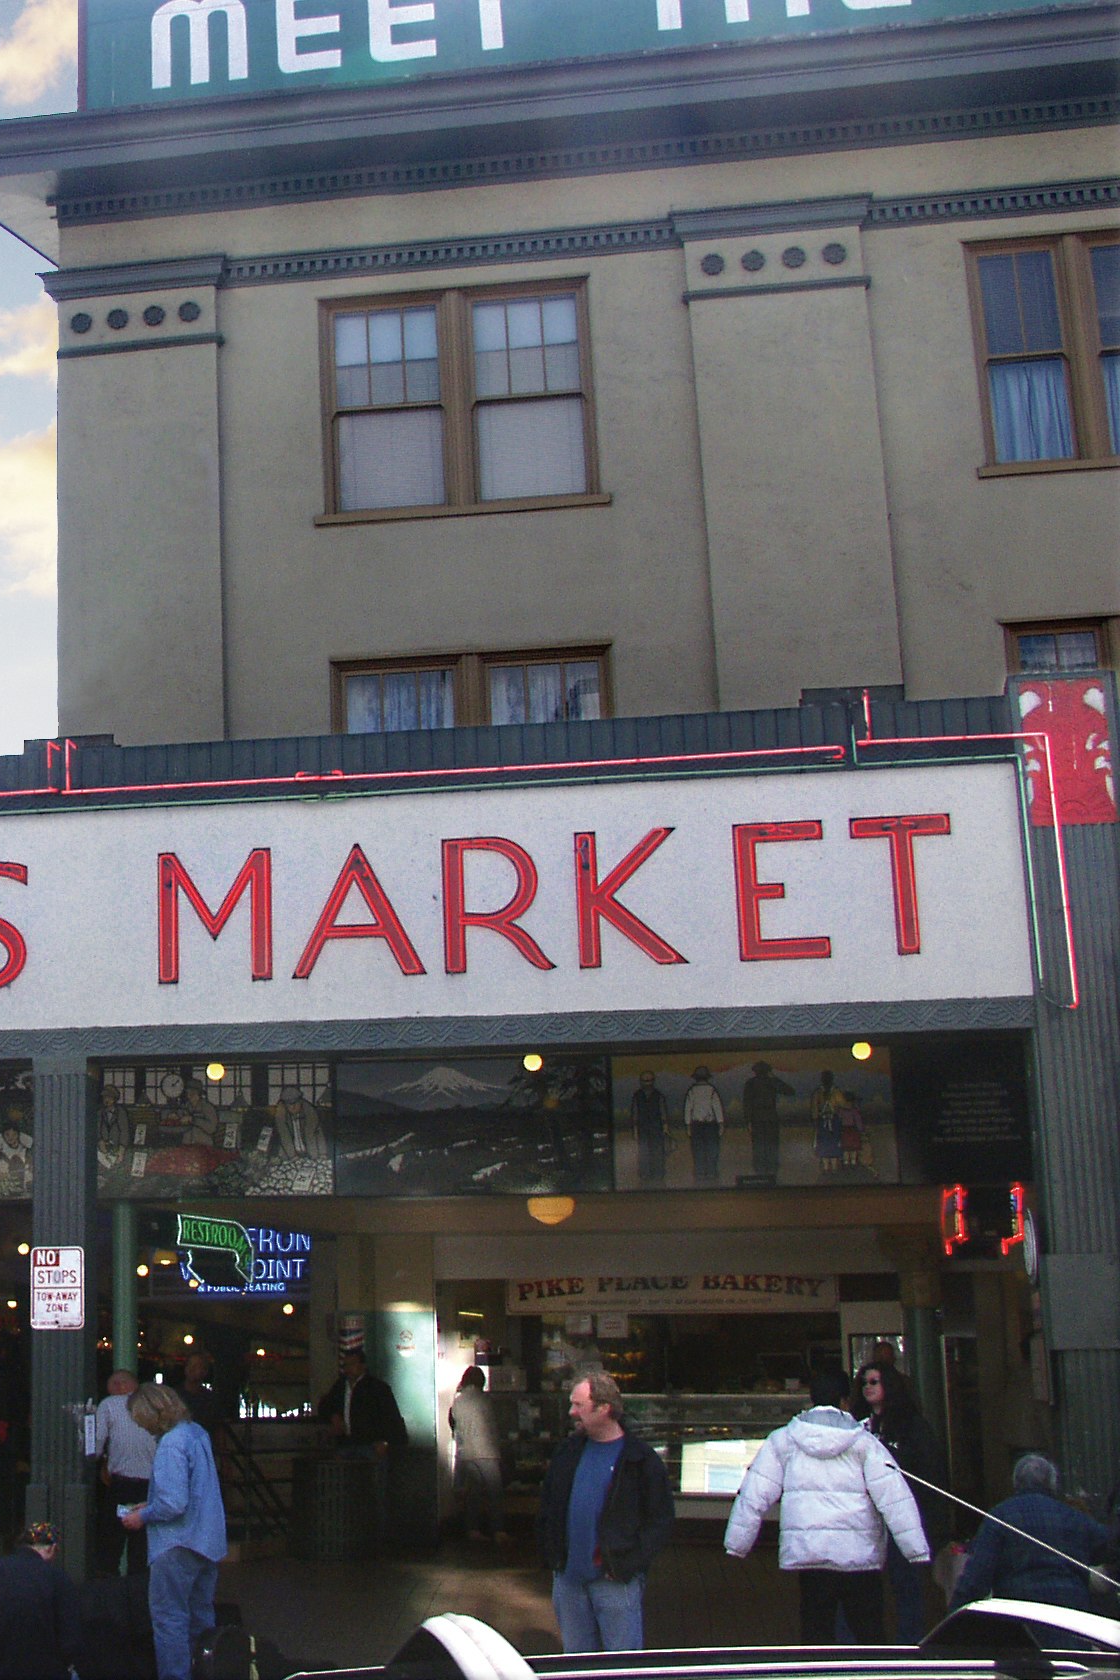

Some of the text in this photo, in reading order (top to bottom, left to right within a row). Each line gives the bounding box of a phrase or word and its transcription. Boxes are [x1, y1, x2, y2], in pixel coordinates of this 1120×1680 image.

[158, 813, 950, 984] MARKET
[36, 1249, 56, 1265] NO
[37, 1269, 77, 1284] STOPS
[517, 1275, 826, 1301] PIKE PLACE BAKERY
[46, 1303, 70, 1313] ZONE
